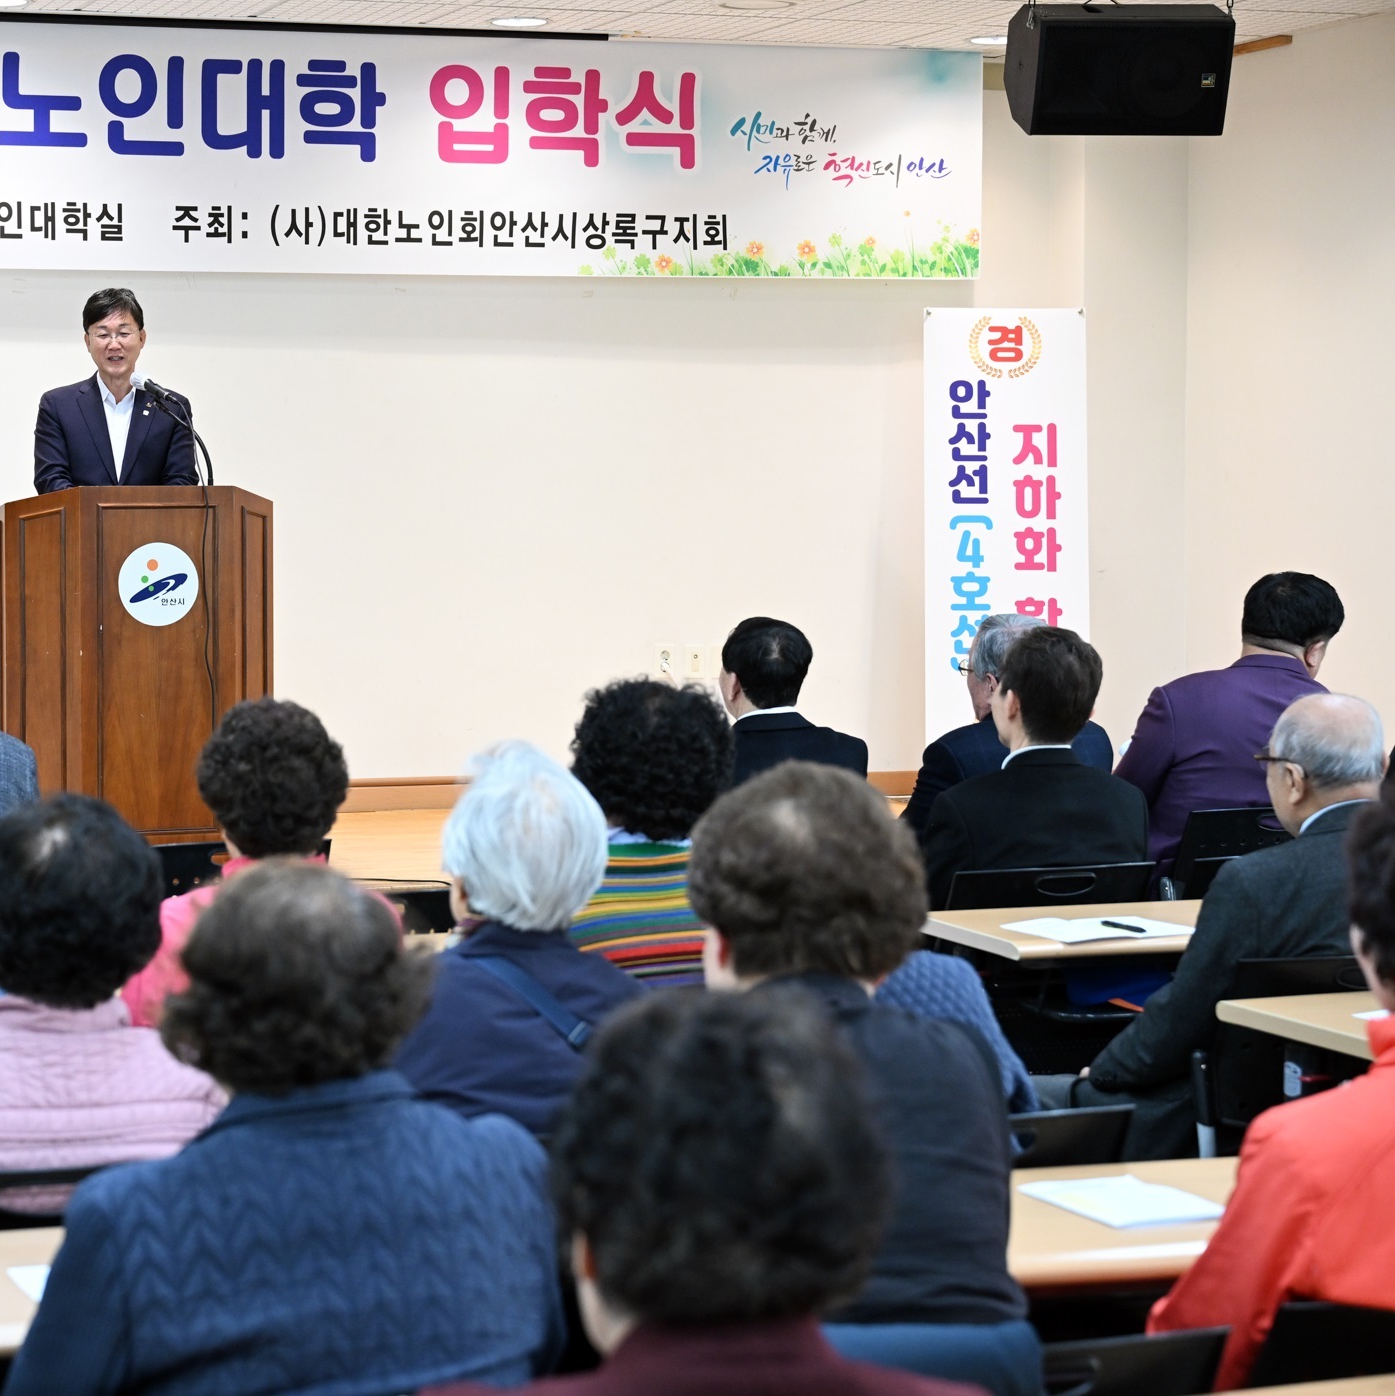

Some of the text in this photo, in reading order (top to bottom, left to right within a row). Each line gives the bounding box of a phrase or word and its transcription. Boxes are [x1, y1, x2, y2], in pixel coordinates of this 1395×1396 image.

[430, 65, 696, 169] 입학식
[730, 111, 794, 151] 시민과
[754, 152, 951, 190] 자유로운 혁신도시 안산
[172, 205, 248, 243] 주최:
[270, 205, 728, 250] (사)대한노인회안산시상록구지회
[988, 325, 1023, 362] 경
[1013, 423, 1062, 572] 지하화
[161, 597, 185, 606] 안산시
